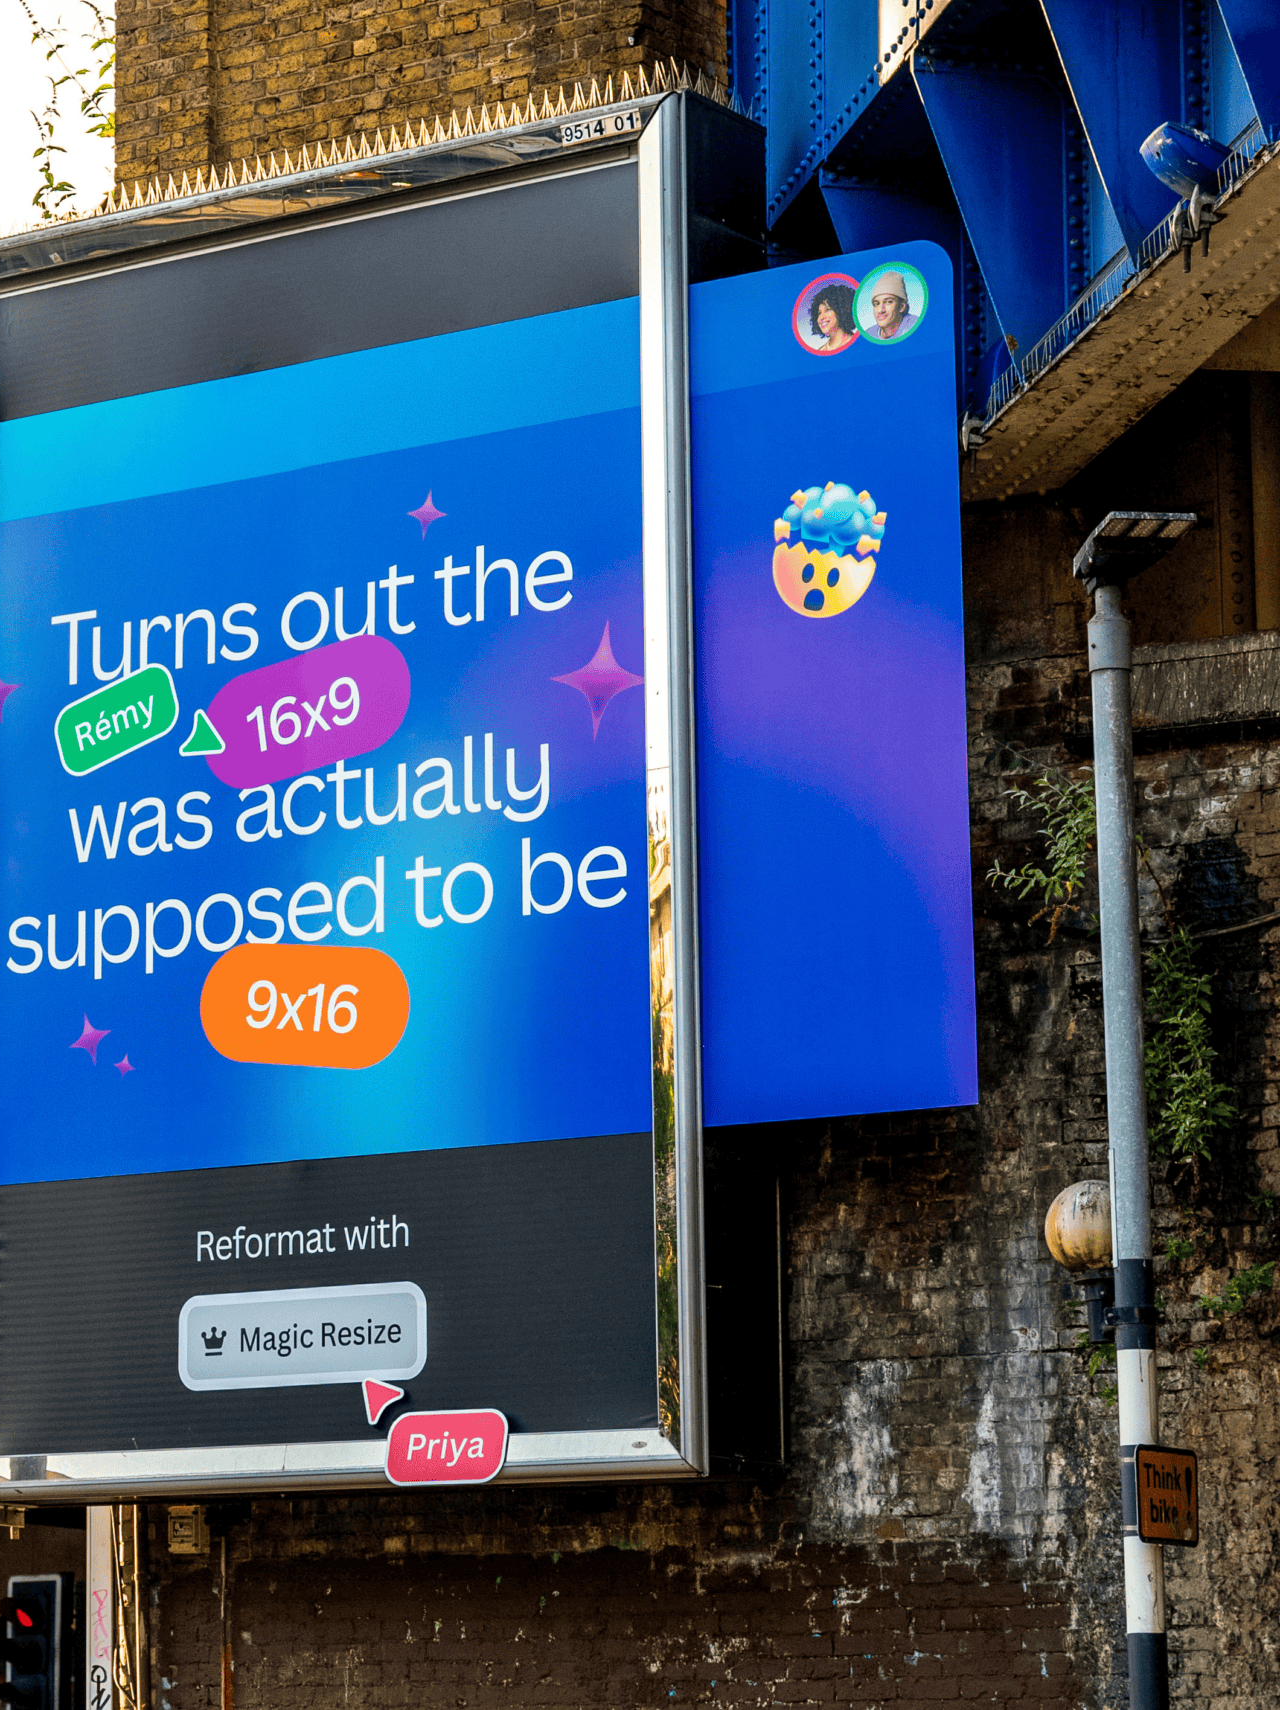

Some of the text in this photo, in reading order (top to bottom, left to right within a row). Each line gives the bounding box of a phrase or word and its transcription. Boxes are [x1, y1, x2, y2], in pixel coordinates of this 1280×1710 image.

[564, 112, 635, 142] 9514 01
[51, 545, 573, 686] Turns out the
[75, 695, 154, 752] Rémy
[246, 676, 360, 752] 16x9
[69, 732, 550, 863] was actually
[6, 837, 628, 979] supposed to be
[246, 980, 359, 1034] 9x16
[196, 1215, 409, 1262] Reformat with
[240, 1318, 402, 1357] Magic Resize
[406, 1431, 485, 1467] Priya
[1143, 1462, 1181, 1492] Think
[1150, 1497, 1179, 1523] bike
